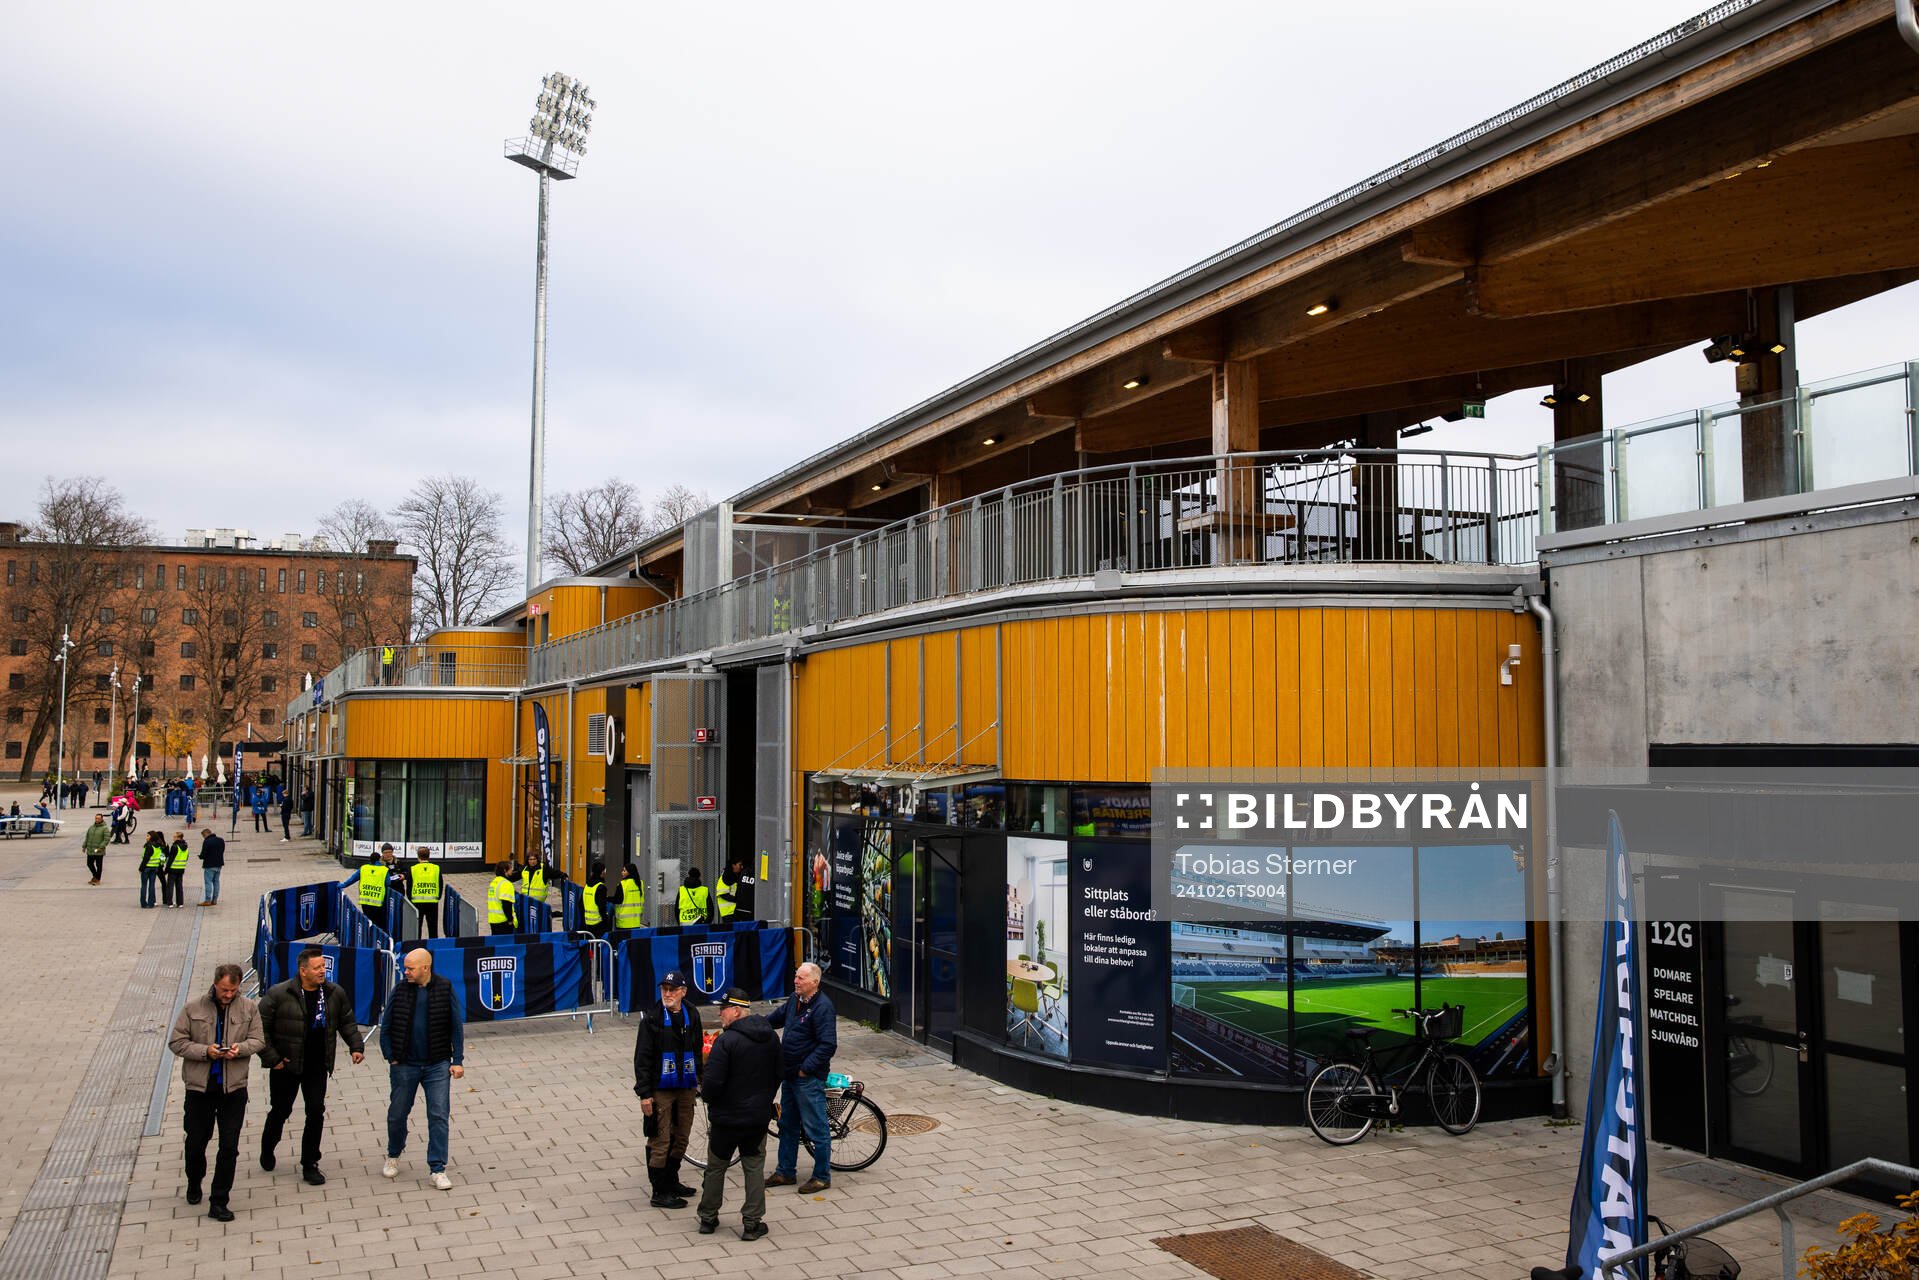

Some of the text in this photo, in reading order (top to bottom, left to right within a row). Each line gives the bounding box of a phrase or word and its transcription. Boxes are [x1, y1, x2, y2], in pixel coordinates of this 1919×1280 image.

[898, 787, 920, 815] 12F
[362, 884, 382, 893] SERVICE
[1084, 887, 1129, 902] Sittplats
[1084, 905, 1157, 921] eller ståbord?
[1084, 932, 1136, 945] Här finns lediga
[1651, 920, 1693, 948] 12G
[694, 944, 723, 955] SIRIUS
[1084, 943, 1147, 957] lokaler att anpassa
[481, 959, 513, 971] SIRIUS
[1084, 955, 1134, 967] till dina behov!
[1653, 967, 1692, 983] DOMARE
[1654, 988, 1694, 1005] SPELARE
[1650, 1008, 1699, 1026] MATCHDEL
[1651, 1029, 1699, 1047] SJUKVÅRD
